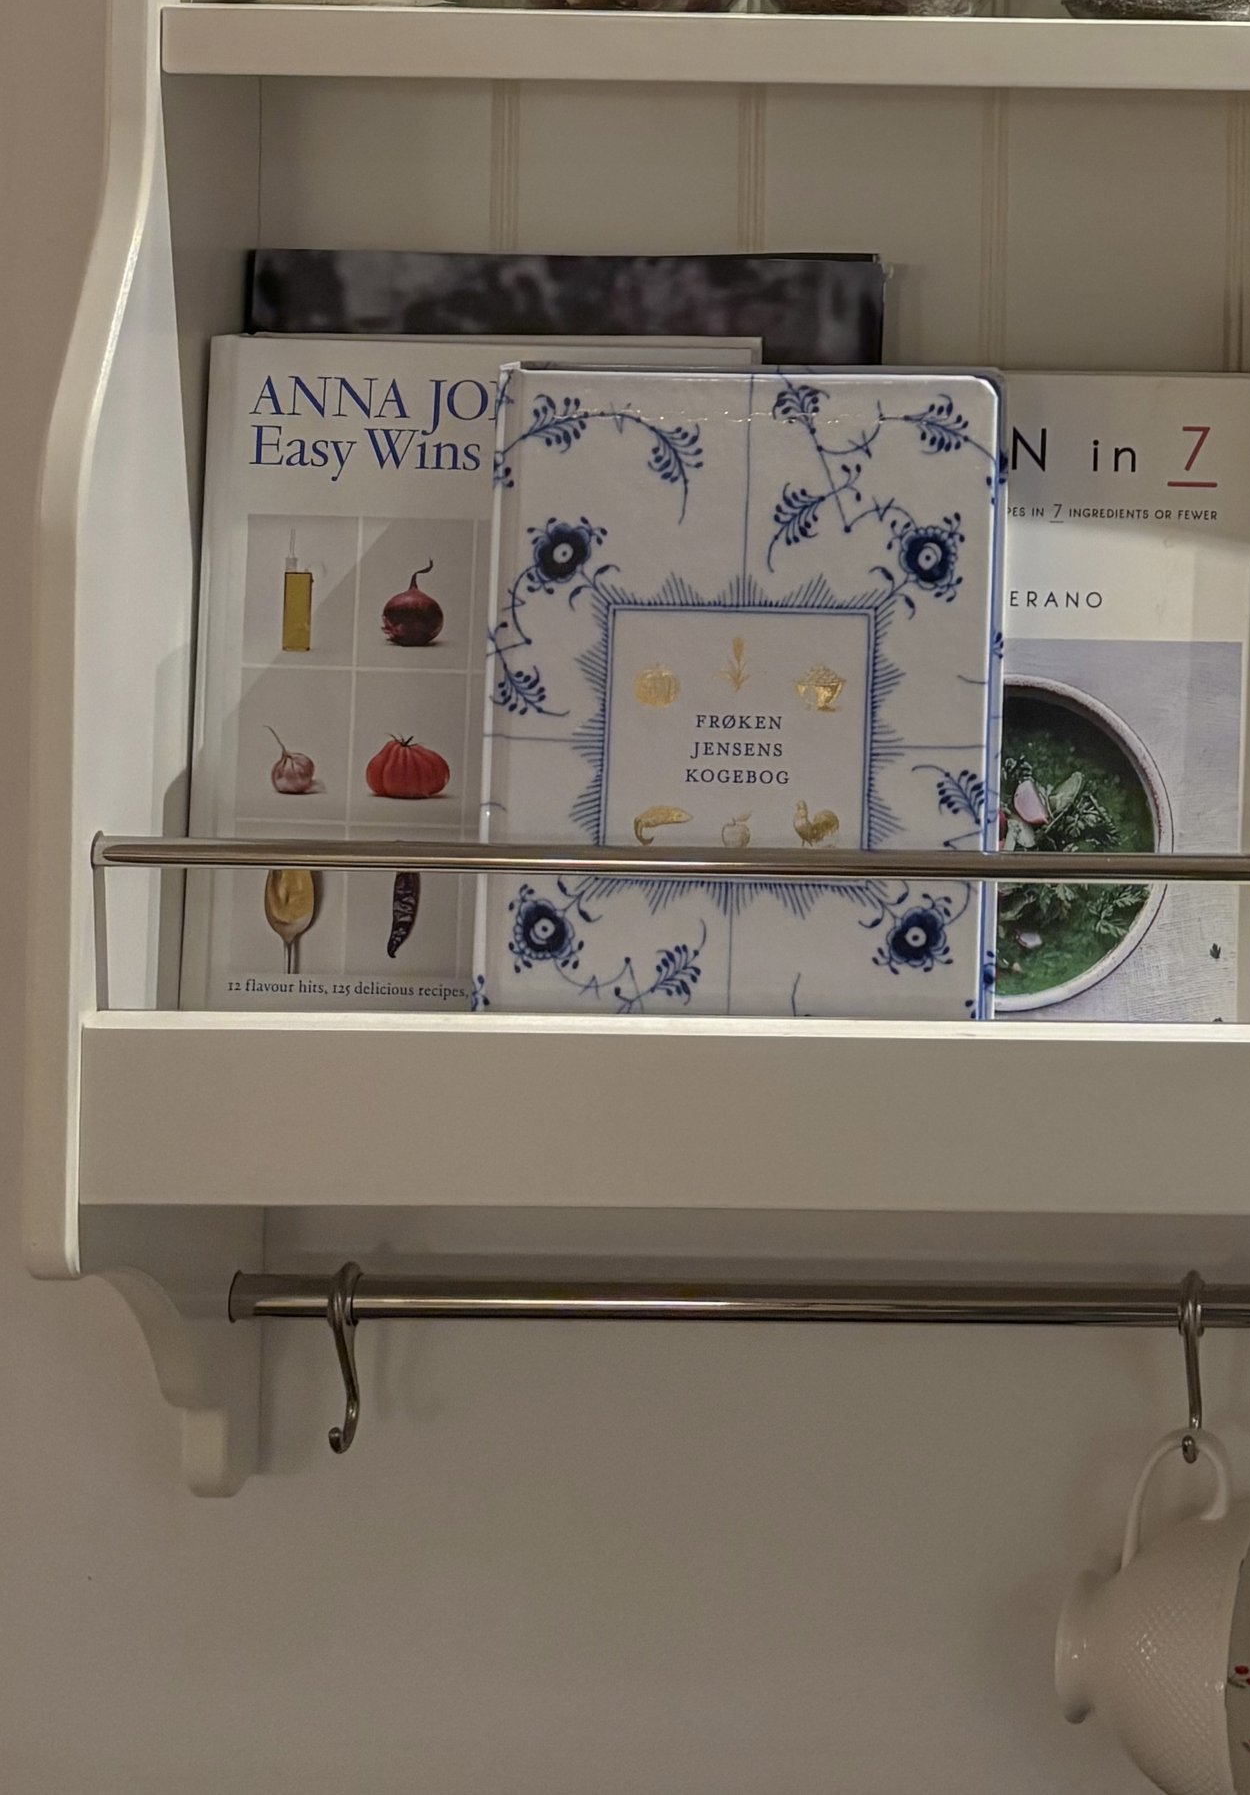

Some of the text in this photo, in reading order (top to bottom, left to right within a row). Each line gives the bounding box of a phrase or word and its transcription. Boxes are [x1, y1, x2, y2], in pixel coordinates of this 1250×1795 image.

[249, 375, 410, 419] ANNA
[249, 425, 481, 482] Easy Wins
[1092, 440, 1136, 473] in
[1182, 426, 1211, 471] 7
[1032, 508, 1044, 519] IN
[1069, 508, 1149, 520] INGREDIENTS
[1155, 510, 1172, 521] OR
[1178, 510, 1218, 521] FEWER
[1009, 590, 1103, 609] ERANO
[696, 714, 782, 730] FRØKEN
[690, 741, 783, 759] JENSENS
[684, 768, 790, 784] KOGEBOG
[228, 979, 469, 1001] 12 flavour hits, 125 delicious recipes,
